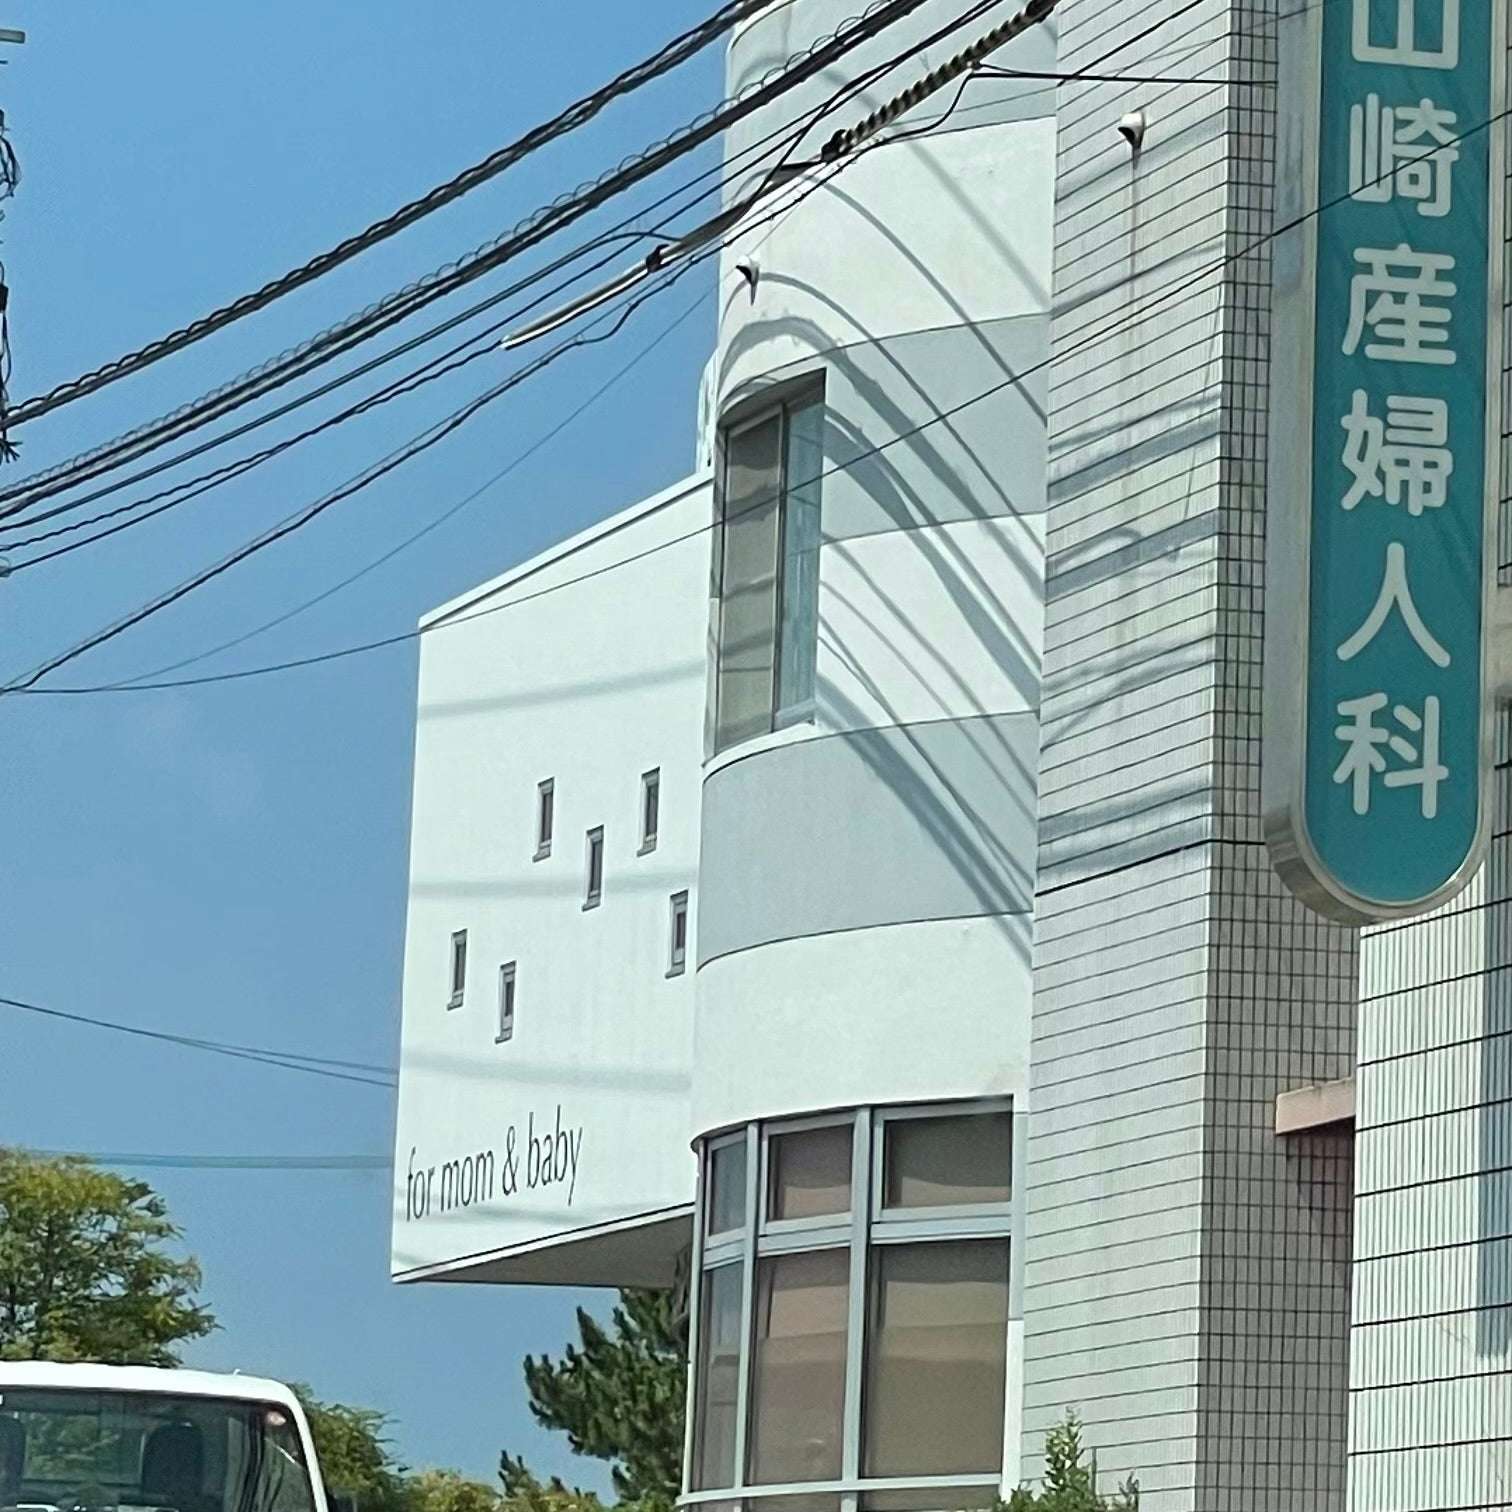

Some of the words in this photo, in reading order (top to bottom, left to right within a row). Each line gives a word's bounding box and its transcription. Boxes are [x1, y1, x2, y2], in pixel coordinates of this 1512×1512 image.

[406, 1146, 436, 1222] for
[440, 1149, 495, 1213] mom
[502, 1125, 520, 1196] &
[526, 1104, 583, 1207] baby
